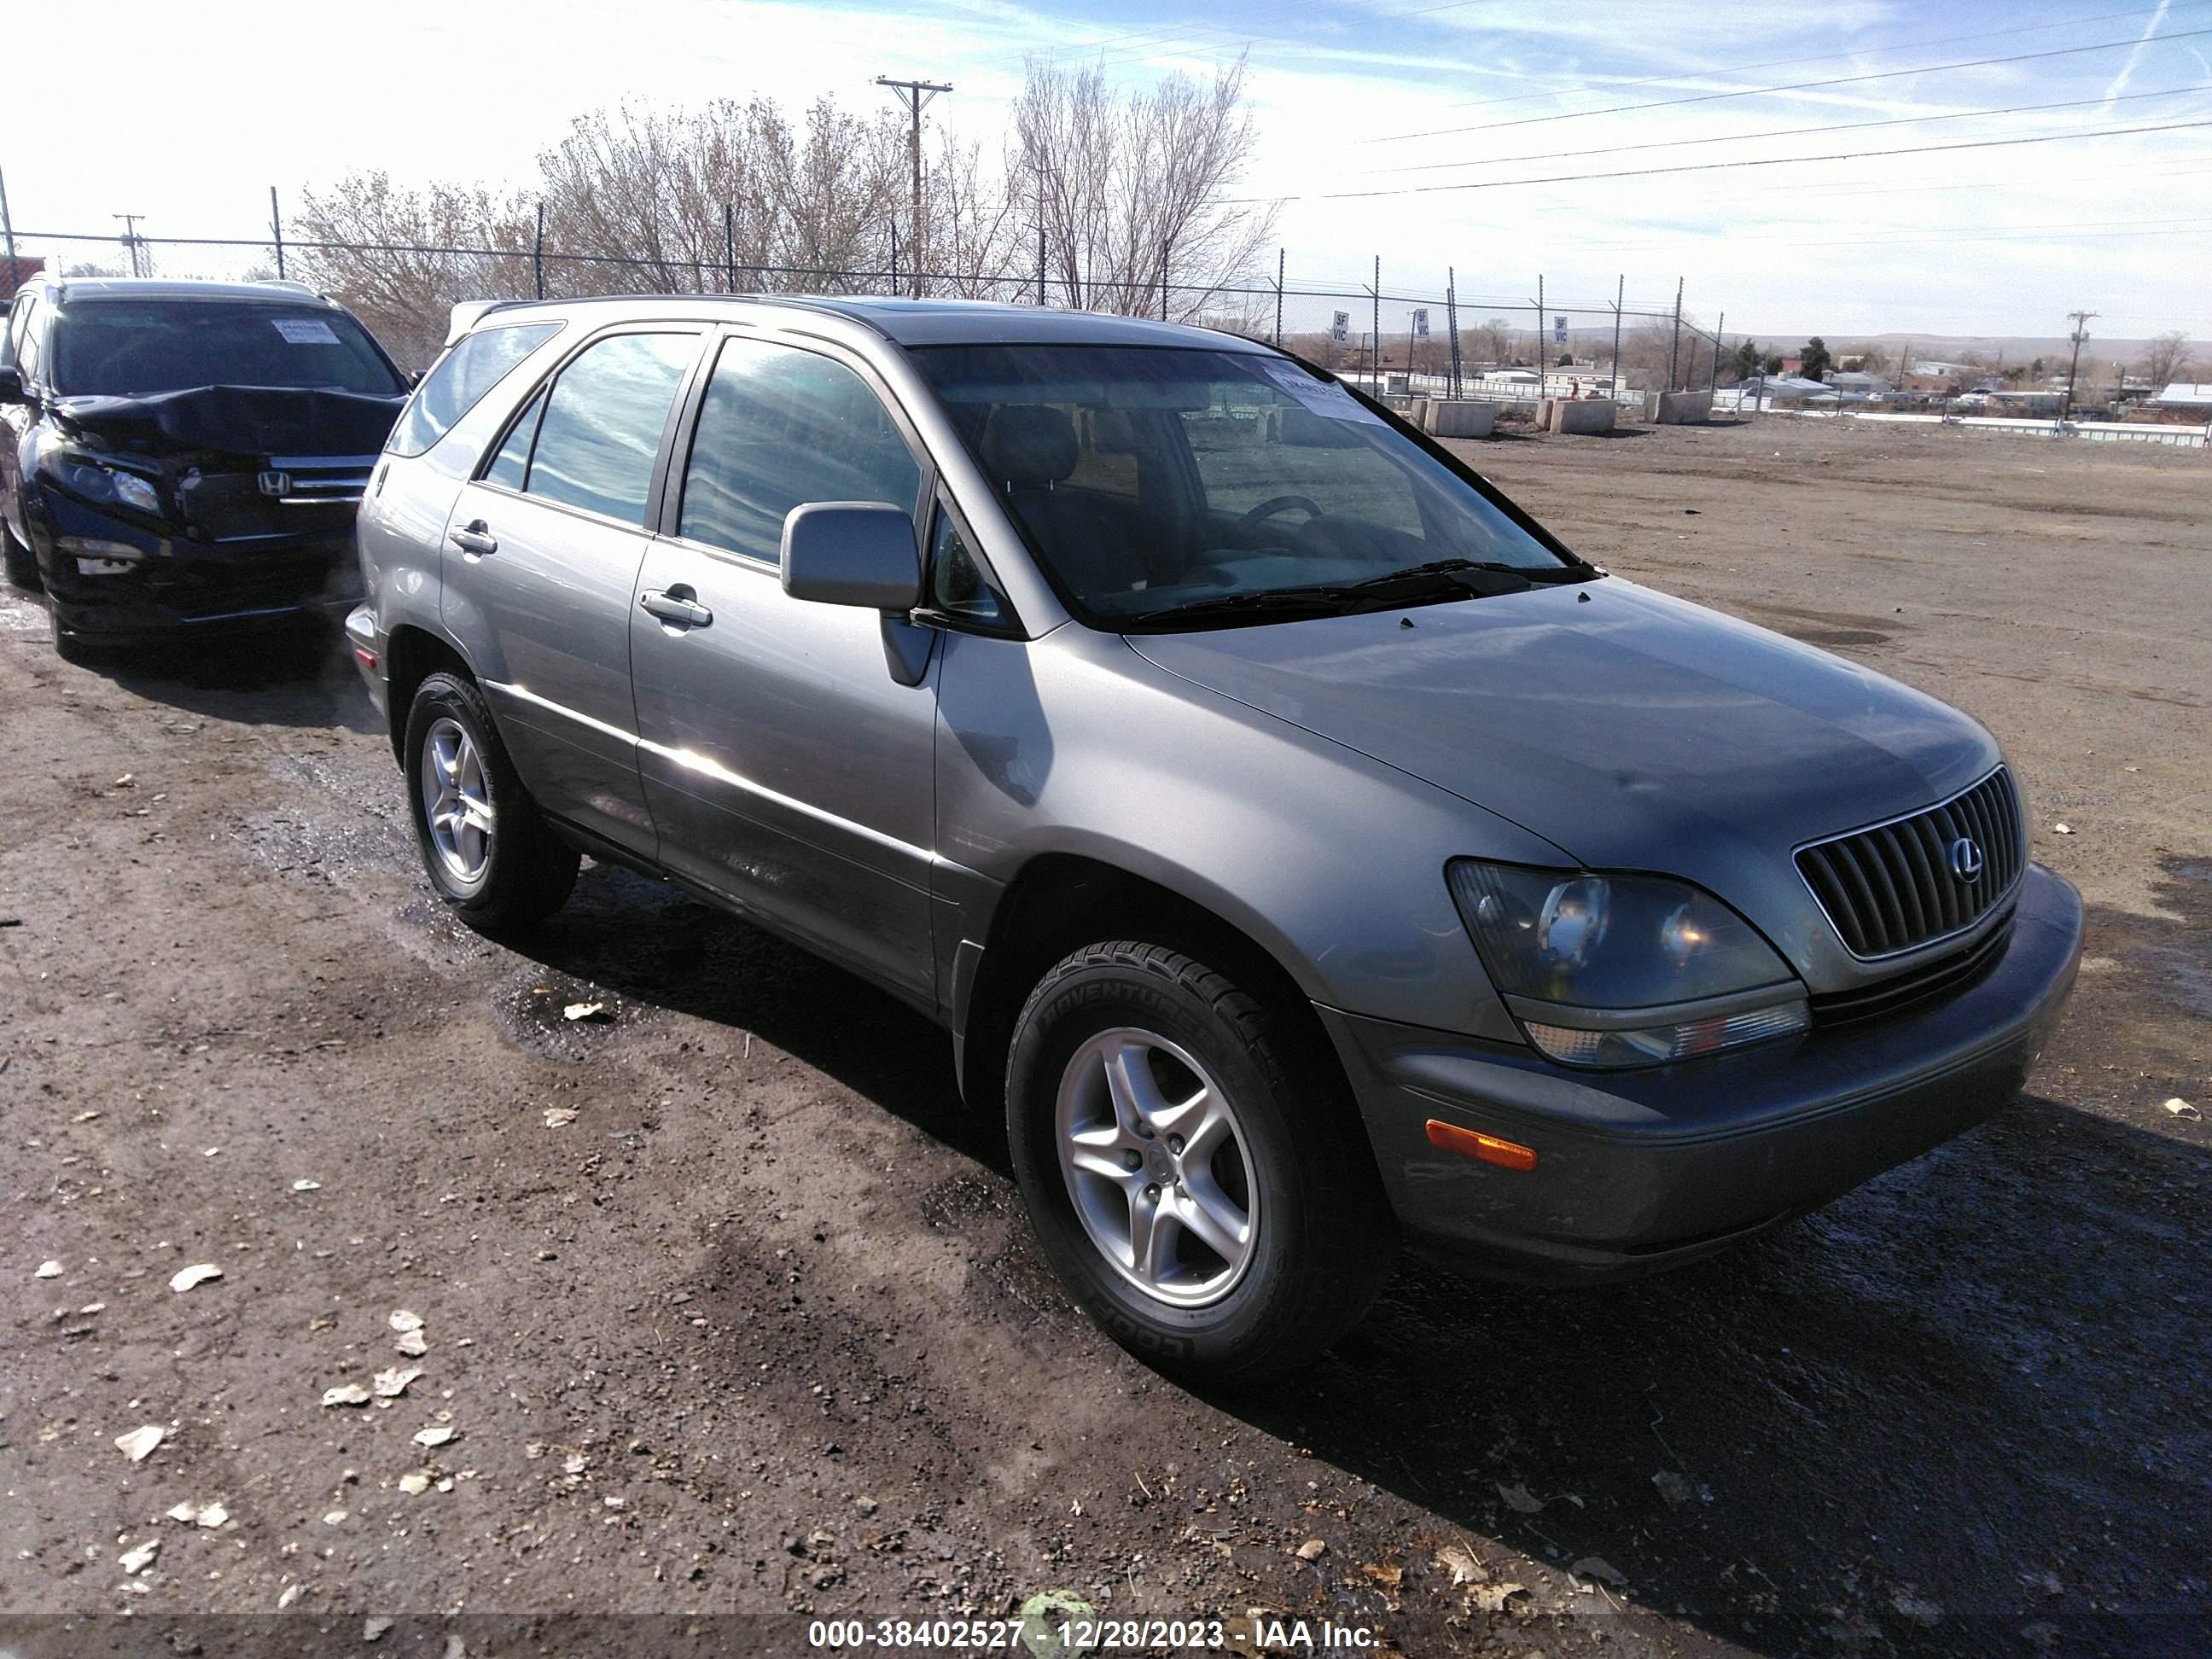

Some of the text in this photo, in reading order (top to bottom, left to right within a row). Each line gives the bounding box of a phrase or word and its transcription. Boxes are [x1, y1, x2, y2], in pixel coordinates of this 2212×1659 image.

[1336, 313, 1346, 326] SF
[1417, 311, 1426, 322] SF
[1557, 318, 1565, 329] SF
[1333, 329, 1346, 341] VIC
[1417, 324, 1429, 336] VIC
[1556, 331, 1567, 342] VIC
